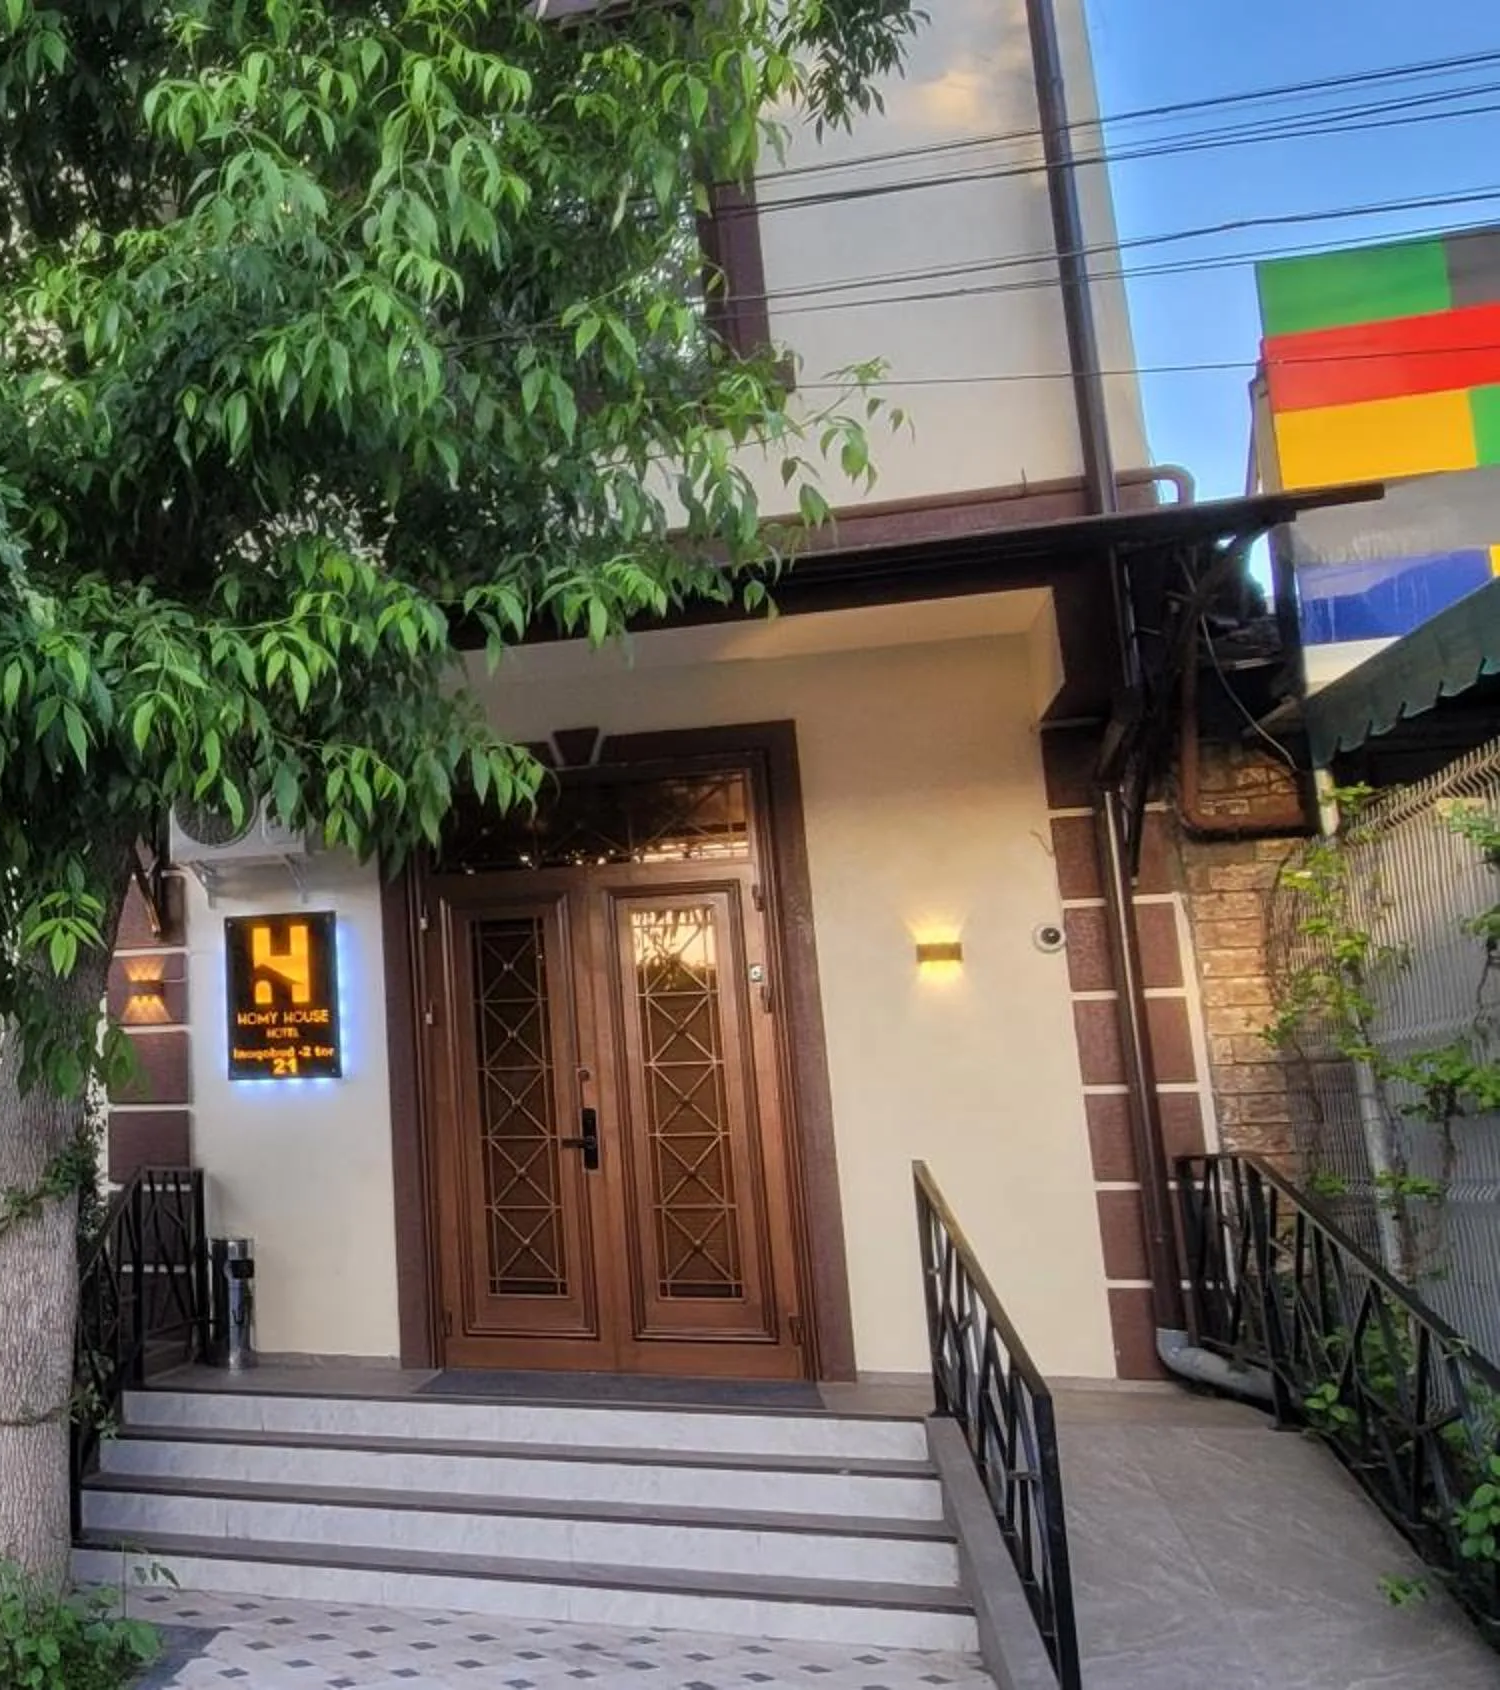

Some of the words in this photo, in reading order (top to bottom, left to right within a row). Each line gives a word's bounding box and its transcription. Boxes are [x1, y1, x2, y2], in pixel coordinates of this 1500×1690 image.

[237, 1011, 278, 1025] HOMY
[283, 1009, 329, 1023] HOUSE
[266, 1027, 299, 1039] HOTEL
[314, 1045, 335, 1057] tor
[273, 1058, 298, 1075] 21
